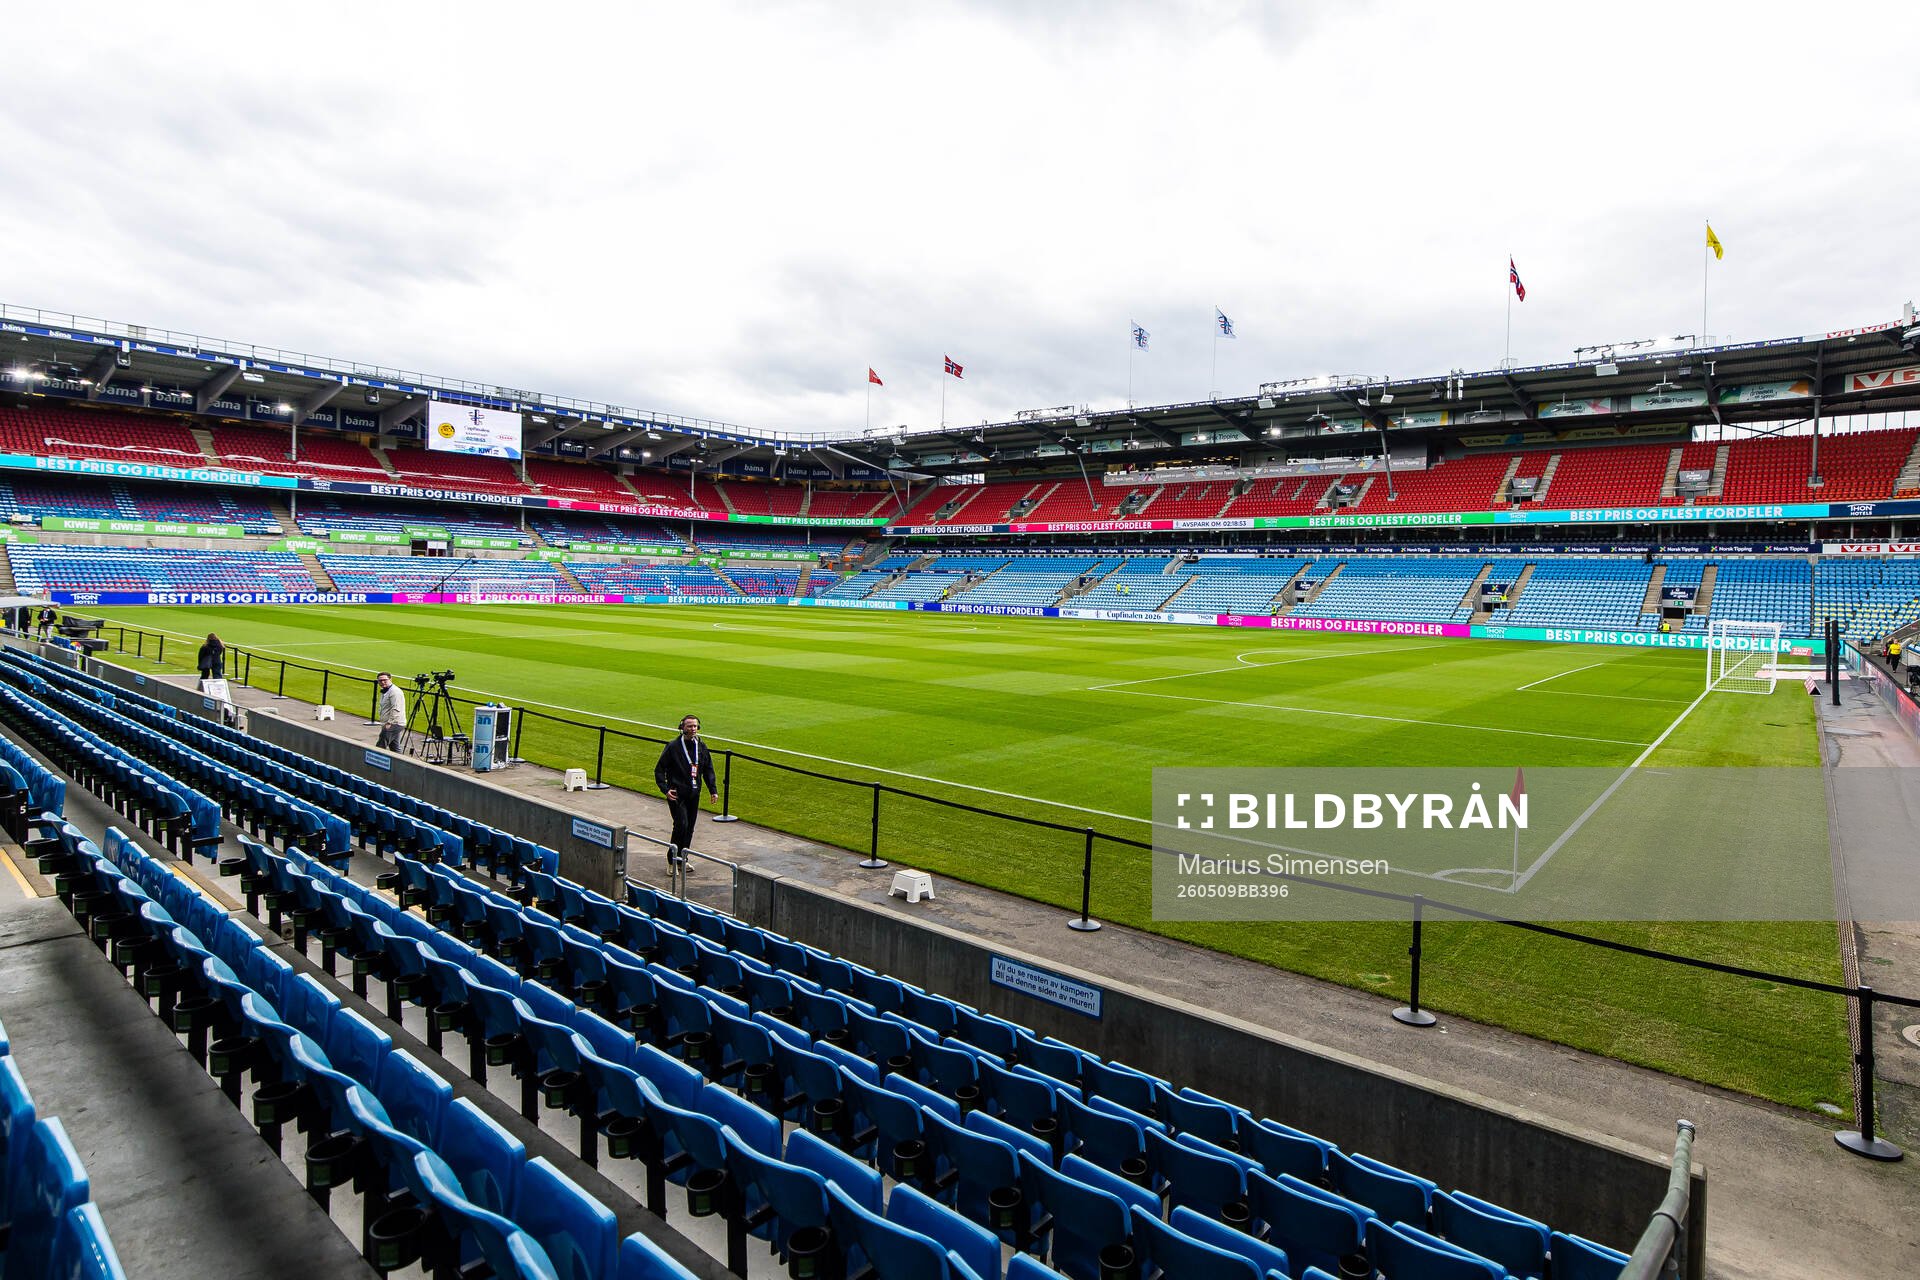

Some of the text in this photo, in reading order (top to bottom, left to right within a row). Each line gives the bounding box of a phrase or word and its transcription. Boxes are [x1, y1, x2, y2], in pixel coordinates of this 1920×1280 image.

[1855, 369, 1920, 389] VG
[346, 416, 375, 428] bama
[36, 458, 260, 485] BEST PRIS OG FLEST FORDELER
[744, 464, 764, 472] bama
[371, 486, 523, 504] BEST PRIS OG FLEST FORDELER
[600, 504, 709, 519] BEST PRIS OG FLEST FORDELER
[1570, 506, 1782, 521] BEST PRIS OG FLEST FORDELER
[64, 520, 88, 528] KIWI
[843, 518, 874, 526] FORDELER
[1310, 514, 1462, 526] BEST PRIS OG FLEST FORDELER
[110, 522, 134, 531] KIWI
[155, 525, 176, 533] KIWI
[197, 526, 217, 535] KIWI
[924, 526, 936, 534] PRIS
[937, 526, 946, 534] OG
[946, 526, 963, 534] FLEST
[1065, 523, 1080, 531] PRIS
[1081, 522, 1092, 530] OG
[1094, 522, 1114, 530] FLEST
[1116, 521, 1152, 530] FORDELER
[286, 540, 307, 549] KIWI
[148, 594, 367, 604] BEST PRIS OG FLEST FORDELER
[456, 594, 606, 603] BEST PRIS OG FLEST FORDELER
[688, 596, 705, 604] PRIS
[707, 596, 718, 604] OG
[720, 596, 740, 604] FLEST
[742, 596, 776, 604] FORDELER
[941, 604, 1044, 616] BEST PRIS OG FLEST FORDELER
[1106, 611, 1143, 620] Cupfinalen
[1271, 617, 1443, 636] BEST PRIS OG FLEST FORDELER
[1546, 628, 1581, 641] BEST
[1585, 631, 1618, 644] PRIS
[1621, 632, 1646, 645] OG
[1651, 634, 1698, 647] FLEST
[1702, 636, 1792, 652] FORDELER
[20, 805, 26, 814] 5
[997, 962, 1006, 970] Vil
[1006, 964, 1016, 974] du
[1026, 973, 1049, 985] resten
[1060, 984, 1094, 999] kampen?
[996, 970, 1004, 979] Bli
[1006, 974, 1014, 983] på
[1016, 978, 1036, 990] denne
[1038, 986, 1058, 997] siden
[1069, 996, 1096, 1010] muren!
